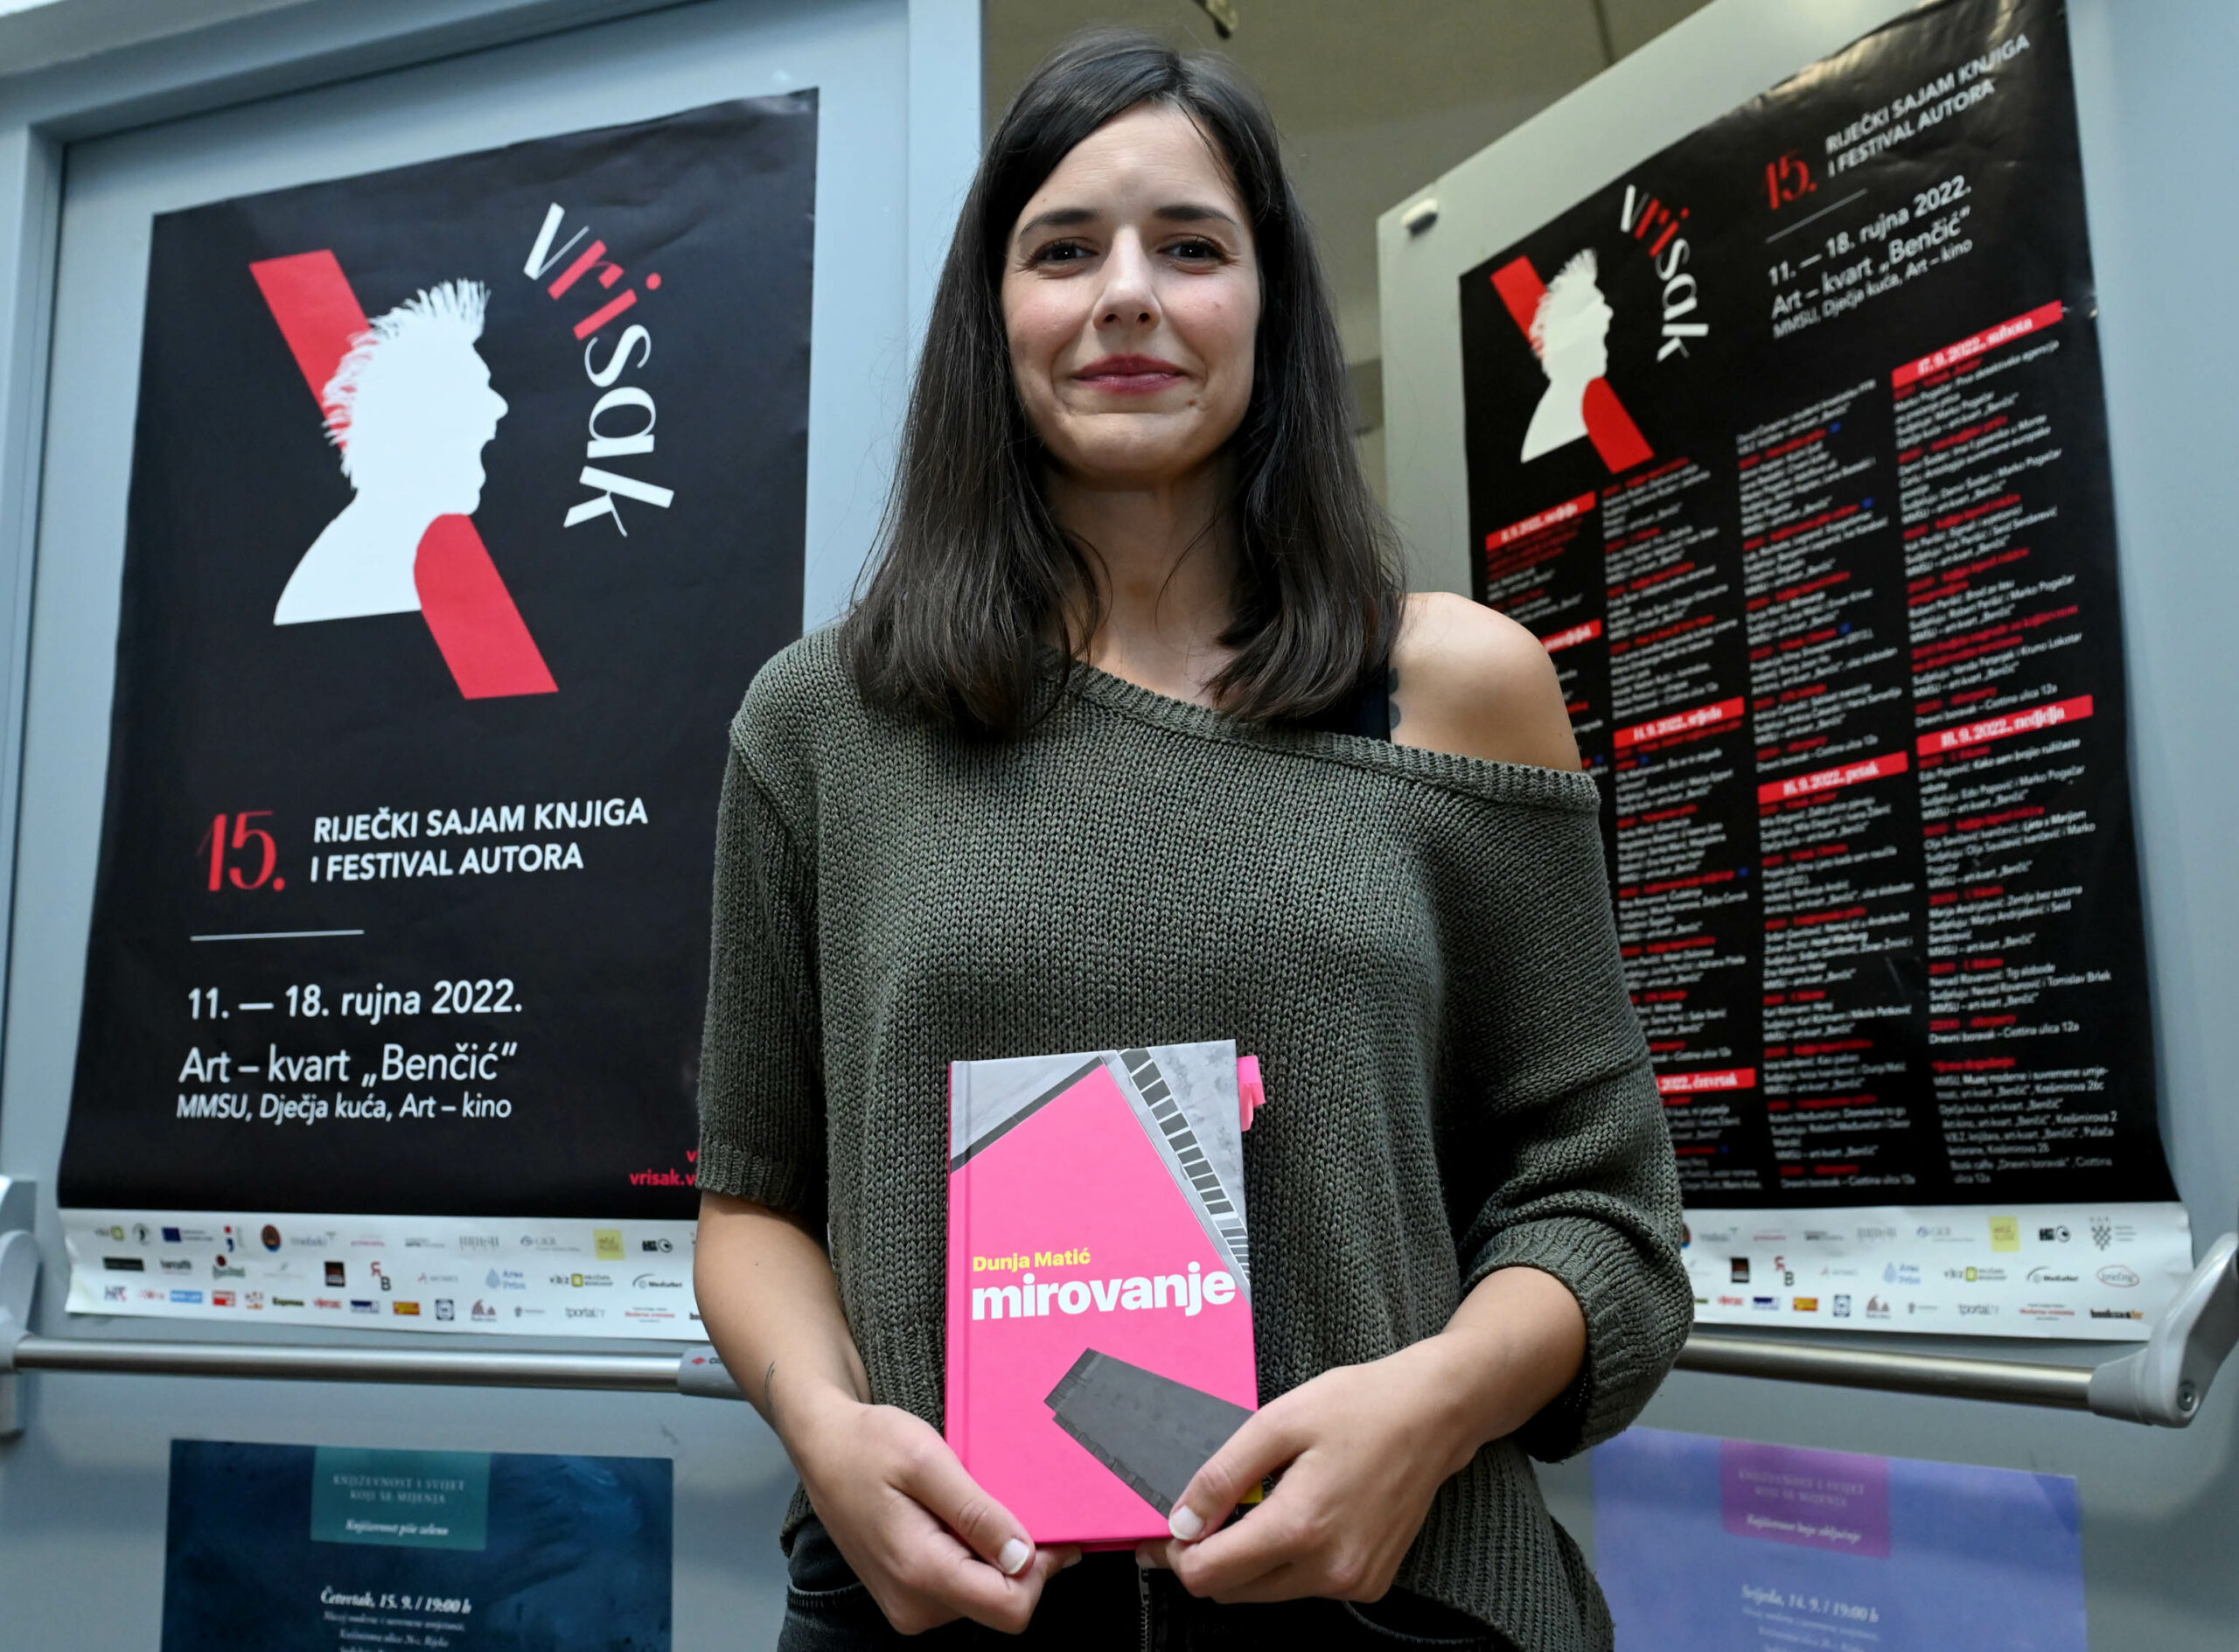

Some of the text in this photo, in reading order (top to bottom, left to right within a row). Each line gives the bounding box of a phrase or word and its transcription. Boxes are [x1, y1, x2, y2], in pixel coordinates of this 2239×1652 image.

[1825, 33, 2030, 155] RIJEČKI SAJAM KNJIGA
[1828, 78, 1995, 178] I FESTIVAL AUTORA
[1762, 150, 1818, 210] 15.
[1768, 261, 1796, 286] 11.
[1826, 232, 1855, 258] 18.
[1859, 208, 1909, 243] rujna
[1914, 175, 1971, 217] 2022.
[1771, 289, 1803, 319] Art
[1822, 257, 1873, 296] kvart
[1773, 240, 1972, 339] MMSU, Dječja kuća, Art kino
[196, 810, 287, 891] 15.
[314, 798, 649, 844] RIJEČKI SAJAM KNJIGA
[310, 842, 584, 882] I FESTIVAL AUTORA
[188, 987, 230, 1019] 11.
[285, 984, 329, 1018] 18.
[342, 982, 421, 1024] rujna
[432, 978, 522, 1014] 2022.
[2062, 1021, 2079, 1032] 12a
[178, 1047, 231, 1084] Art
[269, 1043, 350, 1083] kvart
[177, 1089, 512, 1126] MMSU, Dječja kuća, Art kino
[973, 1248, 1090, 1272] Dunja Matić
[973, 1261, 1236, 1321] mirovanje
